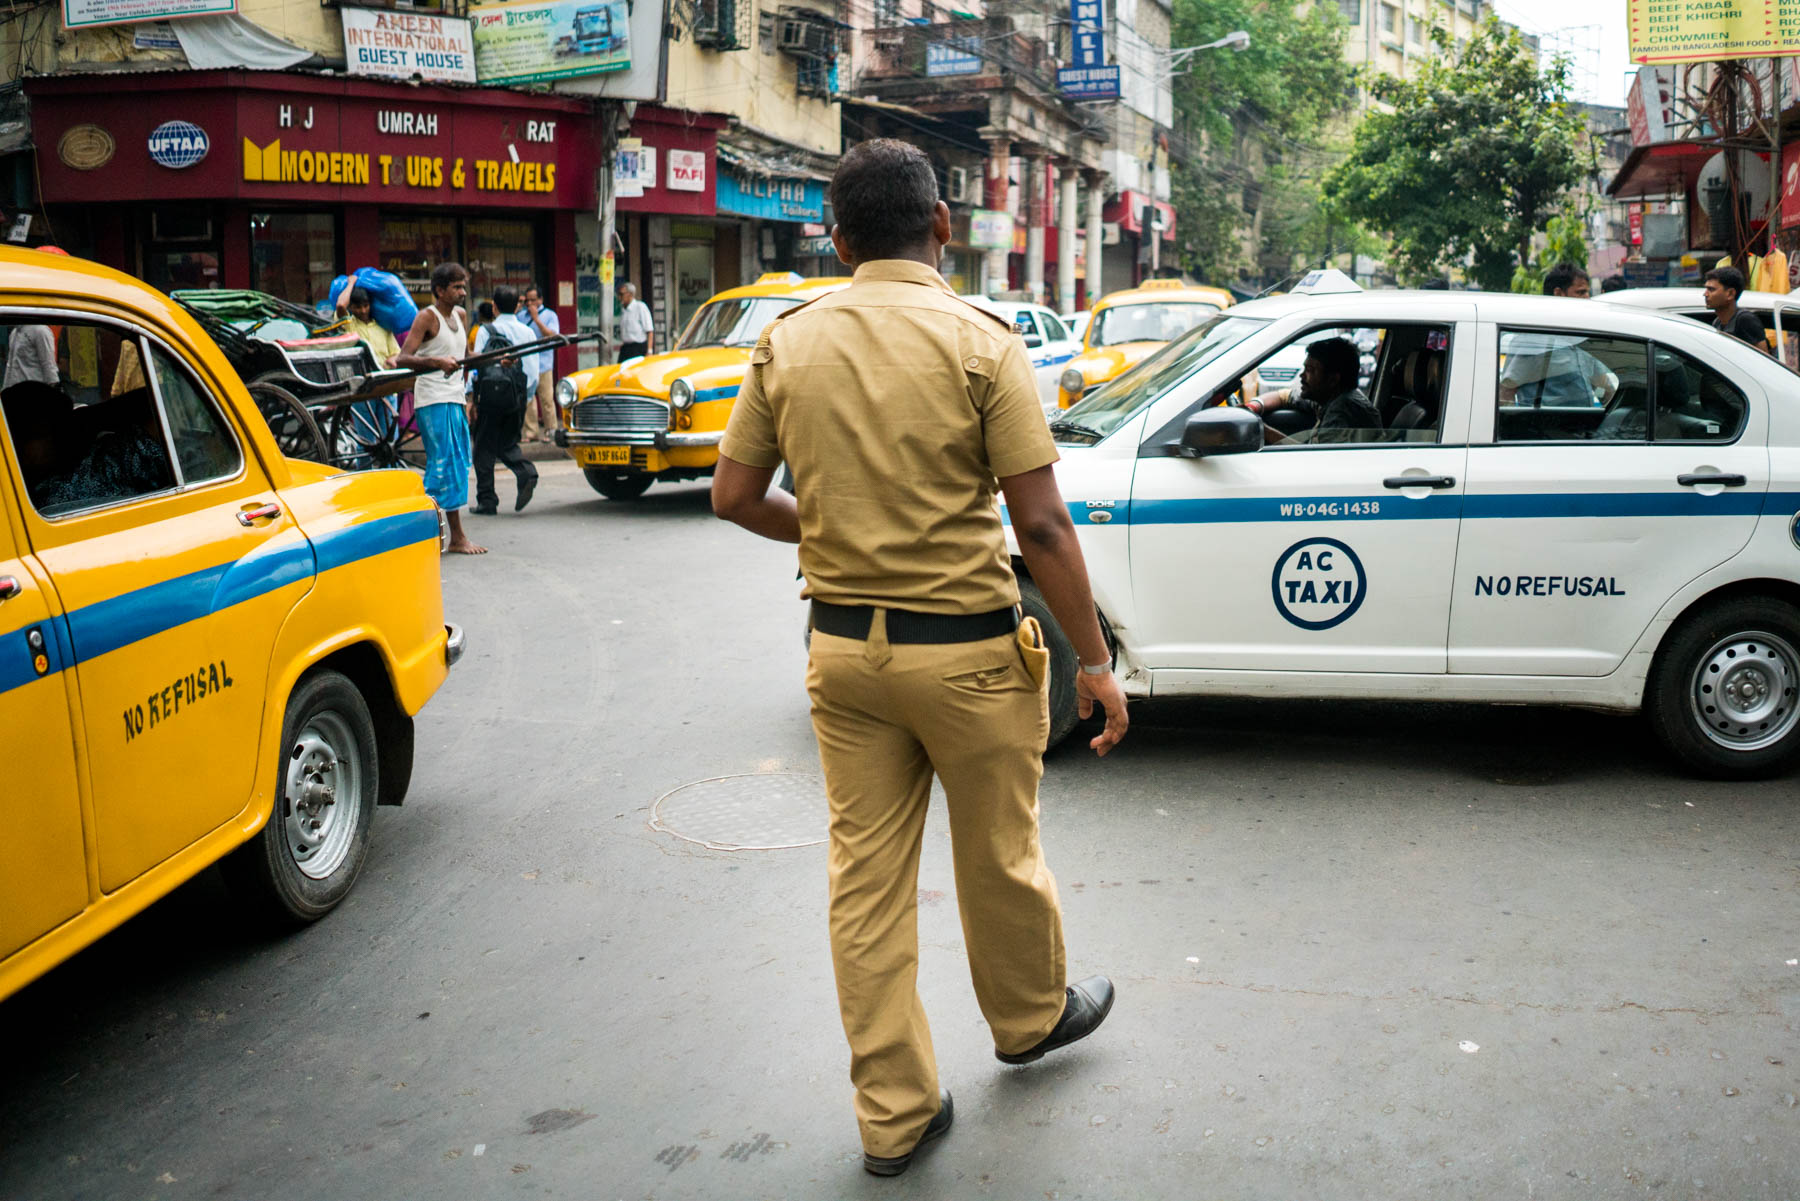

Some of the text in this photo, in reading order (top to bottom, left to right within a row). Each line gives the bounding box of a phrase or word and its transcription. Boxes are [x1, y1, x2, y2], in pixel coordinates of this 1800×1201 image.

[1686, 1, 1733, 11] KABAB
[375, 13, 444, 35] AMEEN
[1649, 10, 1742, 24] BEEF KHICHRI
[1077, 0, 1098, 65] NALI
[1649, 25, 1679, 33] FISH
[1649, 32, 1730, 44] CHOWMIEN
[348, 27, 469, 54] INTERNATIONAL
[1632, 45, 1669, 53] FAMOUS
[1683, 41, 1744, 51] BANGLADESHI
[1747, 39, 1771, 47] FOOD
[359, 48, 408, 66] GUEST
[415, 52, 464, 69] HOUSE
[378, 110, 439, 136] UMRAH
[148, 137, 206, 152] UFTAA
[281, 150, 370, 185] MODERN
[452, 158, 466, 189] &
[475, 160, 556, 193] TRAVELS
[1285, 580, 1352, 604] TAXI
[1475, 576, 1626, 596] NO REFUSAL
[123, 660, 234, 744] NO REFUSAL
